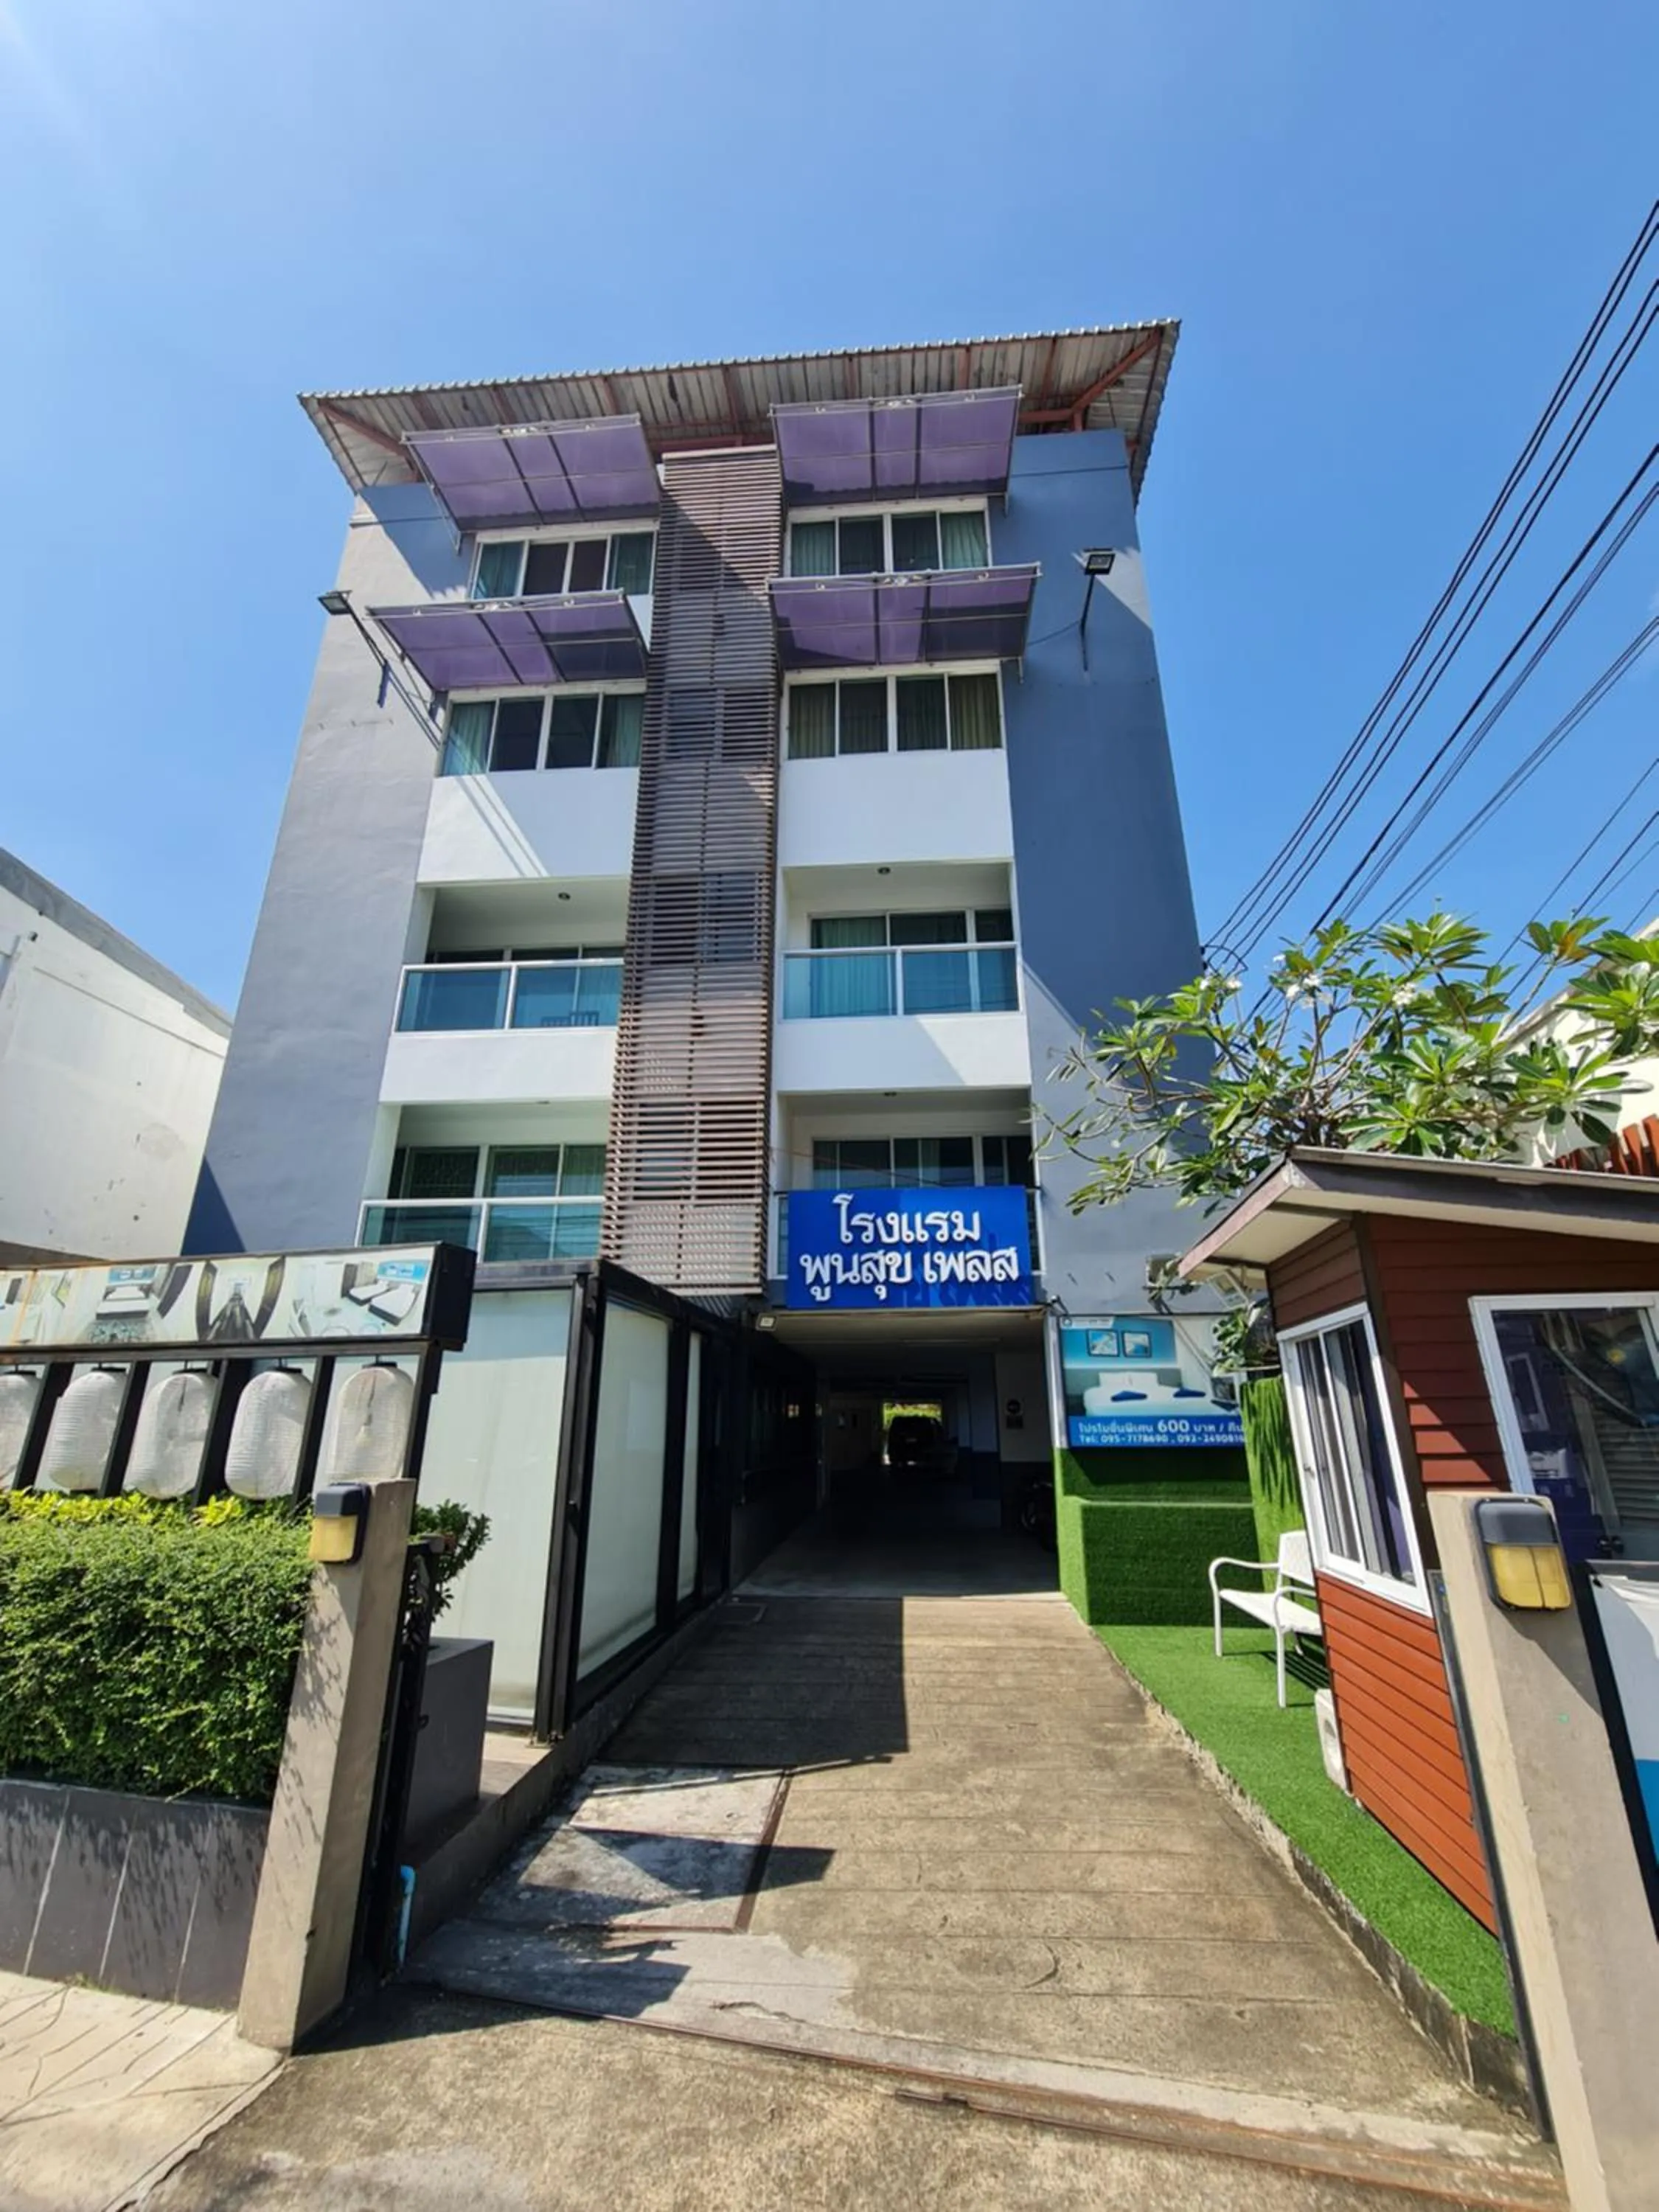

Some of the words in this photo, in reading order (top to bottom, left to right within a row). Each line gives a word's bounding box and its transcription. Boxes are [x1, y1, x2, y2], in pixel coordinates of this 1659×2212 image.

[832, 1193, 980, 1244] โรงแรม
[799, 1251, 913, 1301] พูนสุข
[924, 1246, 1019, 1282] เพลส
[1158, 1419, 1189, 1433] 600
